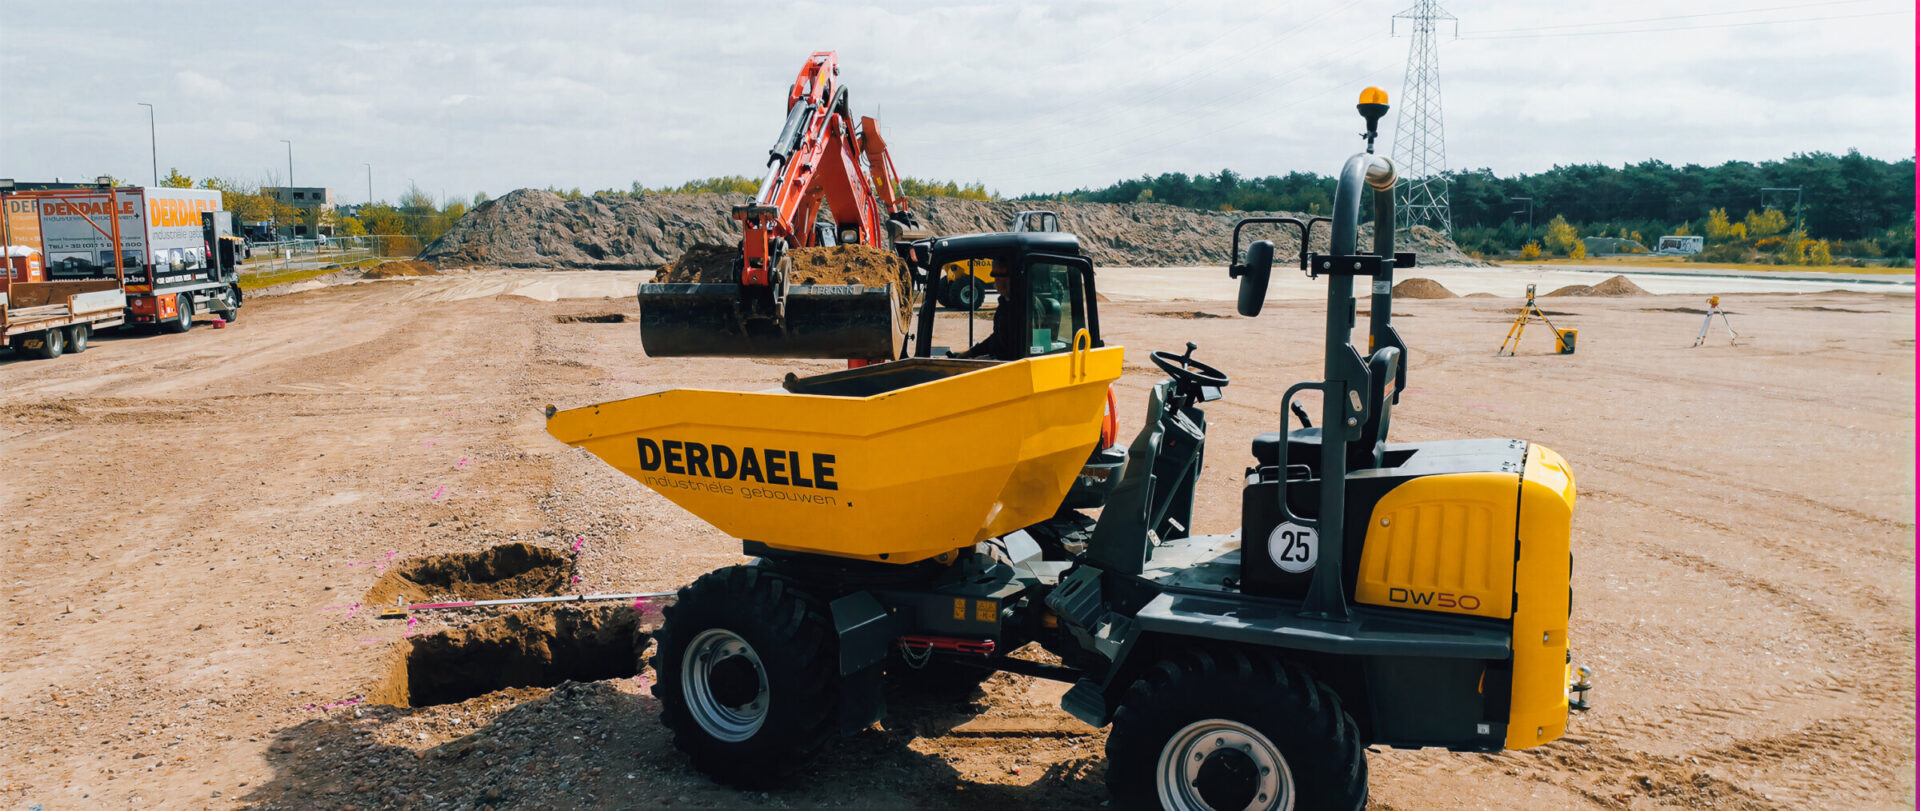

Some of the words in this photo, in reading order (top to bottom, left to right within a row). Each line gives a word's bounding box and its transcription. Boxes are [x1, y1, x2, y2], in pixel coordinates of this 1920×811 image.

[637, 437, 839, 491] DERDAELE
[740, 486, 837, 506] gebouwen
[1280, 530, 1311, 563] 25
[1389, 587, 1481, 611] DW50
